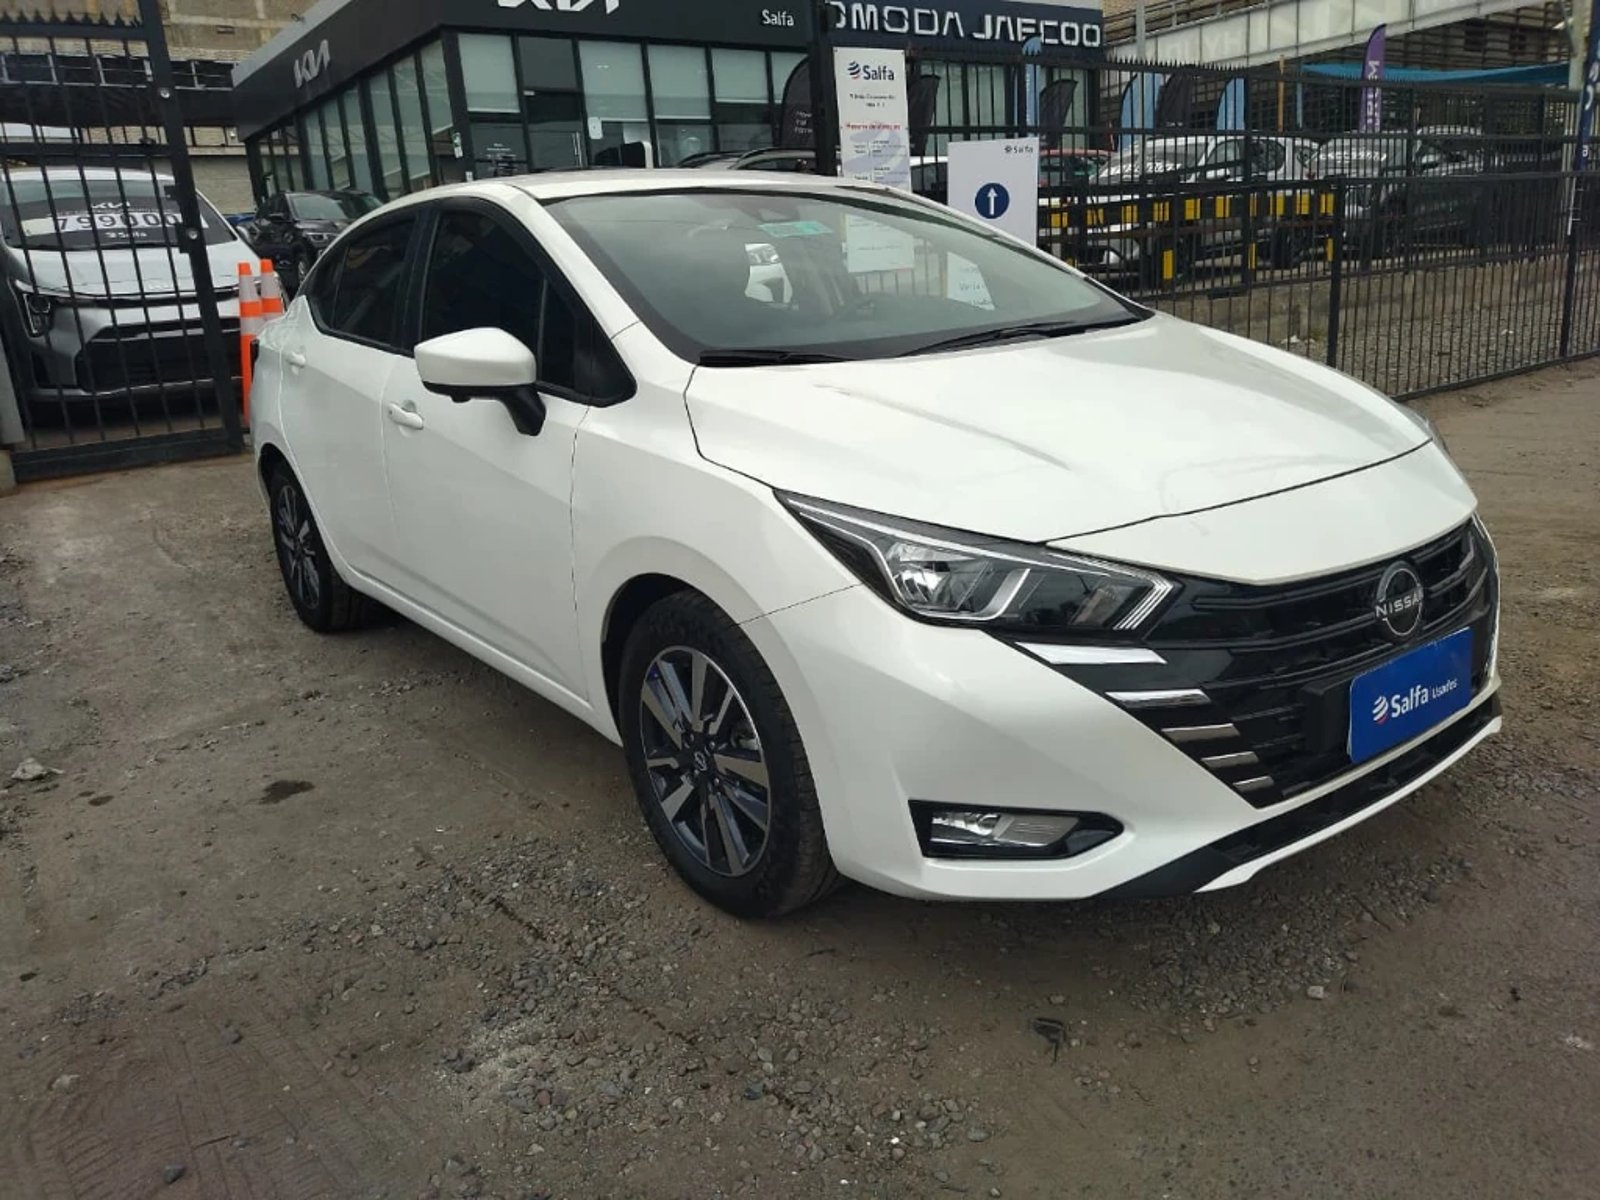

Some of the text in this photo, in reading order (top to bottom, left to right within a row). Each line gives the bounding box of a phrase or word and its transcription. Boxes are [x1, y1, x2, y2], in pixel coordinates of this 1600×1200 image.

[762, 9, 794, 26] Salfa
[972, 14, 1100, 47] JAECOO
[293, 39, 330, 88] KIA
[862, 64, 895, 81] Salfa
[1391, 684, 1429, 718] Salfa
